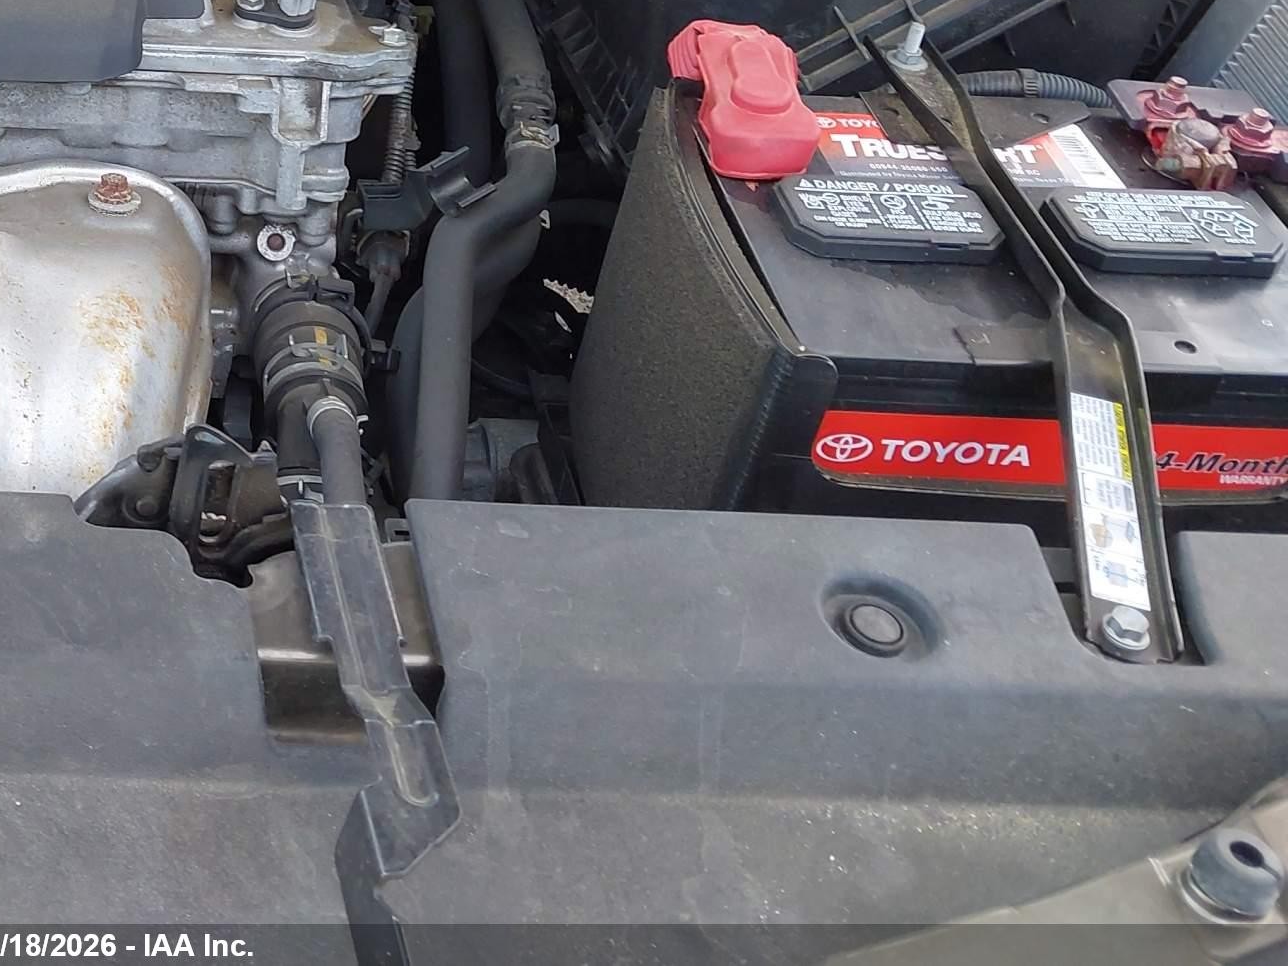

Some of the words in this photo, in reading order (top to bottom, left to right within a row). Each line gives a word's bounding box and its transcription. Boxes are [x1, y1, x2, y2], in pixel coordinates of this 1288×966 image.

[813, 179, 879, 192] DANGER
[882, 182, 890, 192] /
[892, 182, 954, 194] POISON
[881, 439, 1030, 467] TOYOTA
